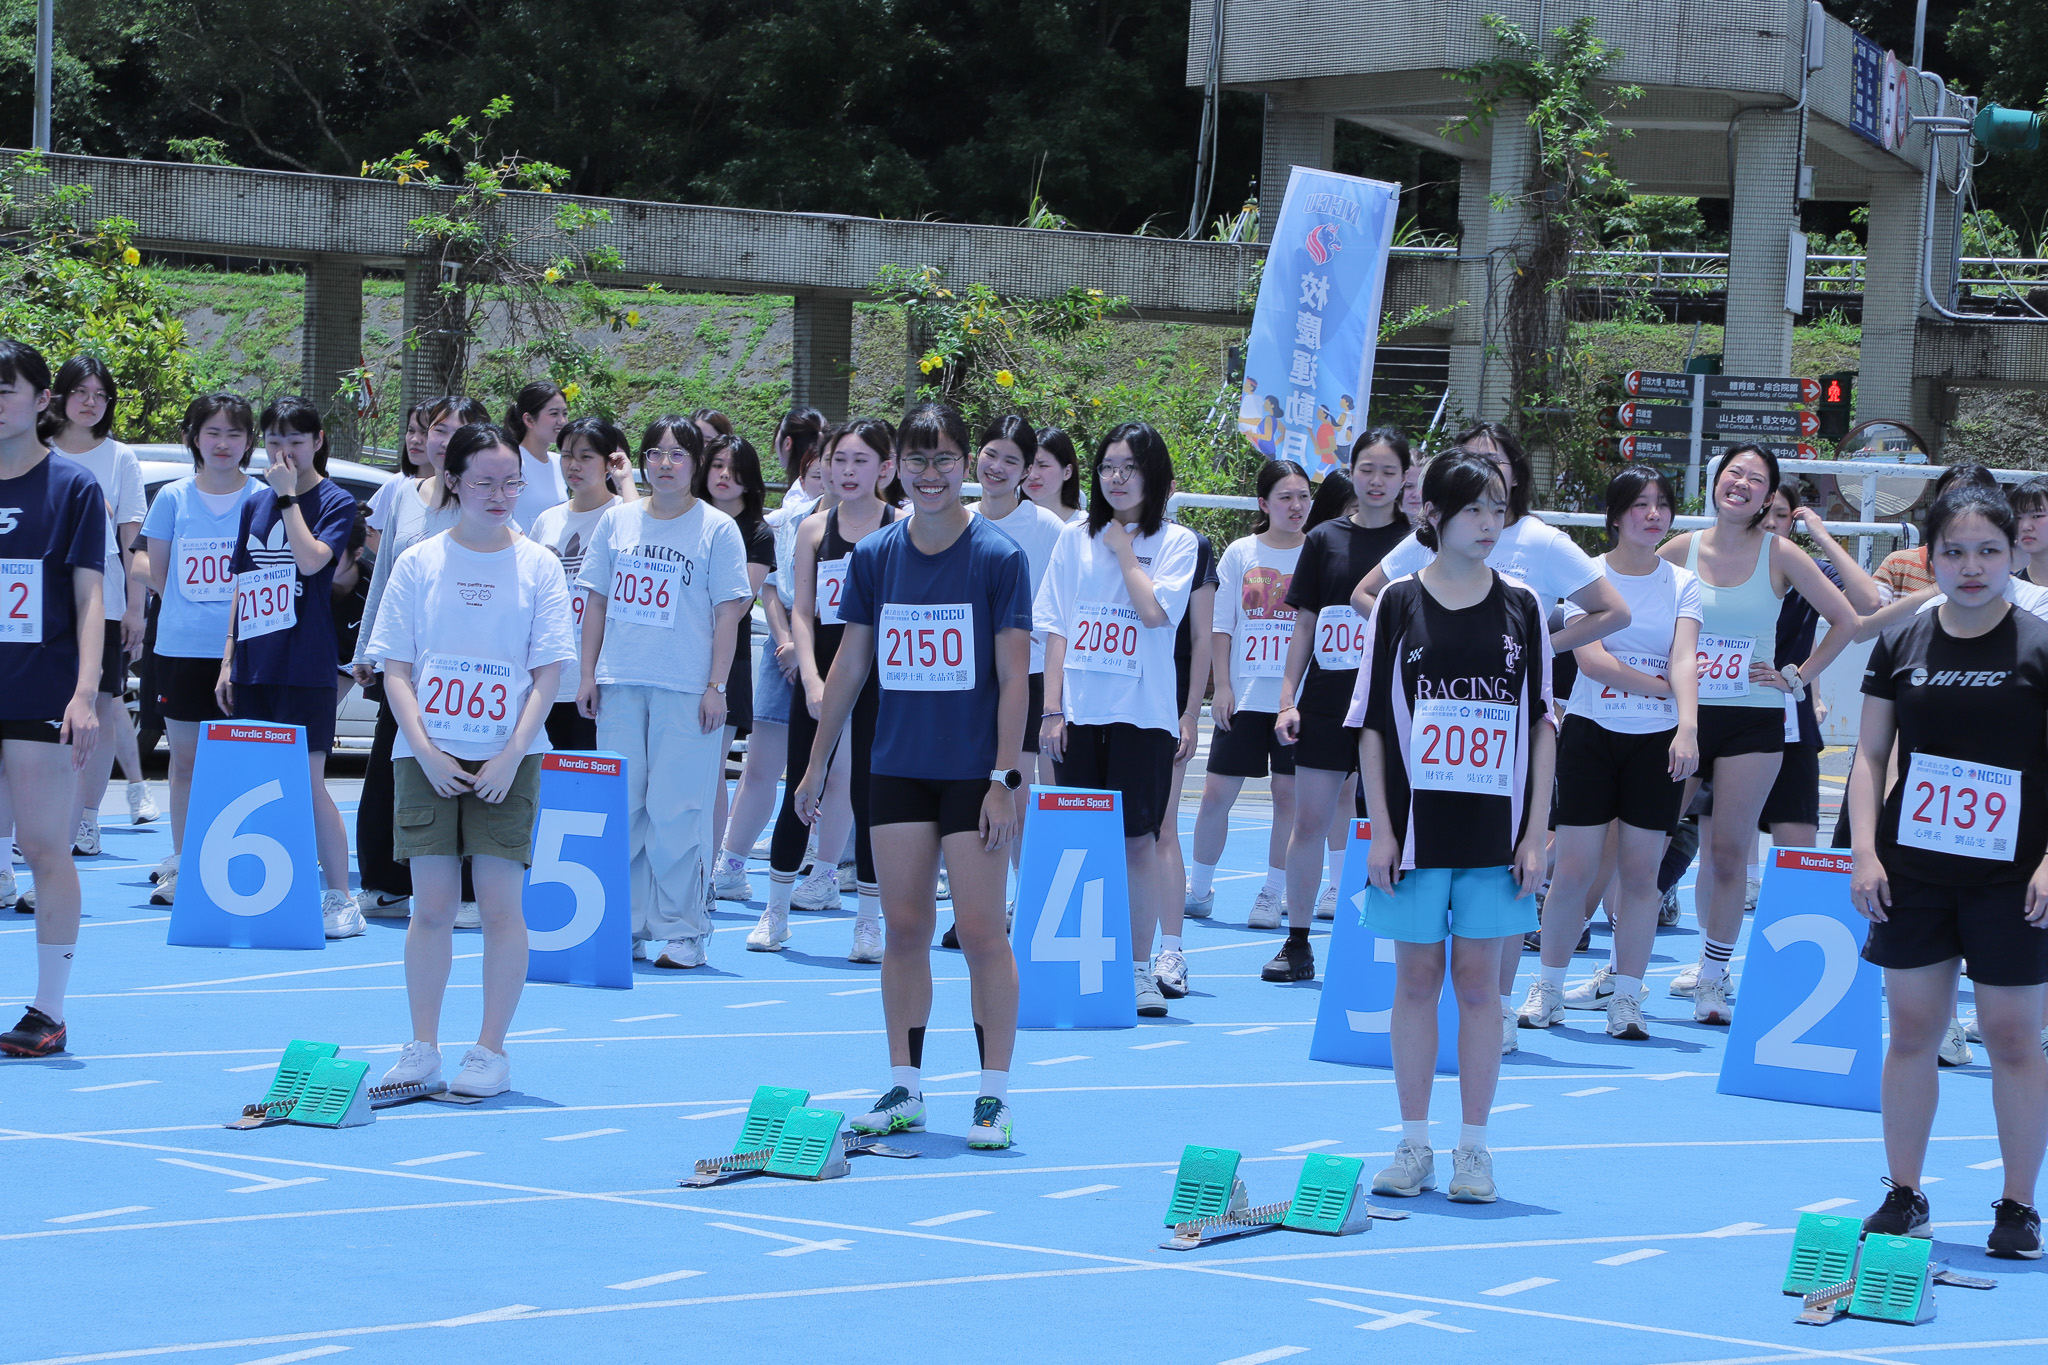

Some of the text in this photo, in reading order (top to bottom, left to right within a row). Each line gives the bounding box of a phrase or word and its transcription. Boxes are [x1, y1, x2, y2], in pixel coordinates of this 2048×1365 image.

[1, 563, 33, 574] NCCU
[185, 555, 233, 585] 200
[269, 568, 291, 580] NCCU
[650, 562, 676, 573] NCCU
[614, 571, 670, 608] 2036
[239, 584, 289, 622] 2130
[932, 609, 965, 621] NCCU
[1074, 620, 1137, 656] 2080
[1321, 623, 1365, 653] 206
[1724, 639, 1750, 649] NCCU
[886, 628, 963, 667] 2150
[482, 663, 510, 677] NCCU
[1928, 671, 2008, 687] HI-TEC
[425, 676, 507, 721] 2063
[1416, 676, 1515, 704] RACING
[1483, 708, 1510, 722] NCCU
[230, 728, 291, 741] Nordic Sport
[1421, 724, 1508, 769] 2087
[558, 758, 616, 773] Nordic Sport
[1425, 770, 1454, 781] 財管系
[1977, 769, 2012, 786] NCCU
[1057, 796, 1110, 809] Nordic Sport
[1912, 781, 2007, 833] 2139
[1913, 828, 1942, 841] 心理系
[200, 778, 294, 917] 6
[1800, 856, 1834, 869] Nordic
[528, 808, 608, 952] 5
[1030, 848, 1116, 996] 4
[1753, 913, 1859, 1076] 2
